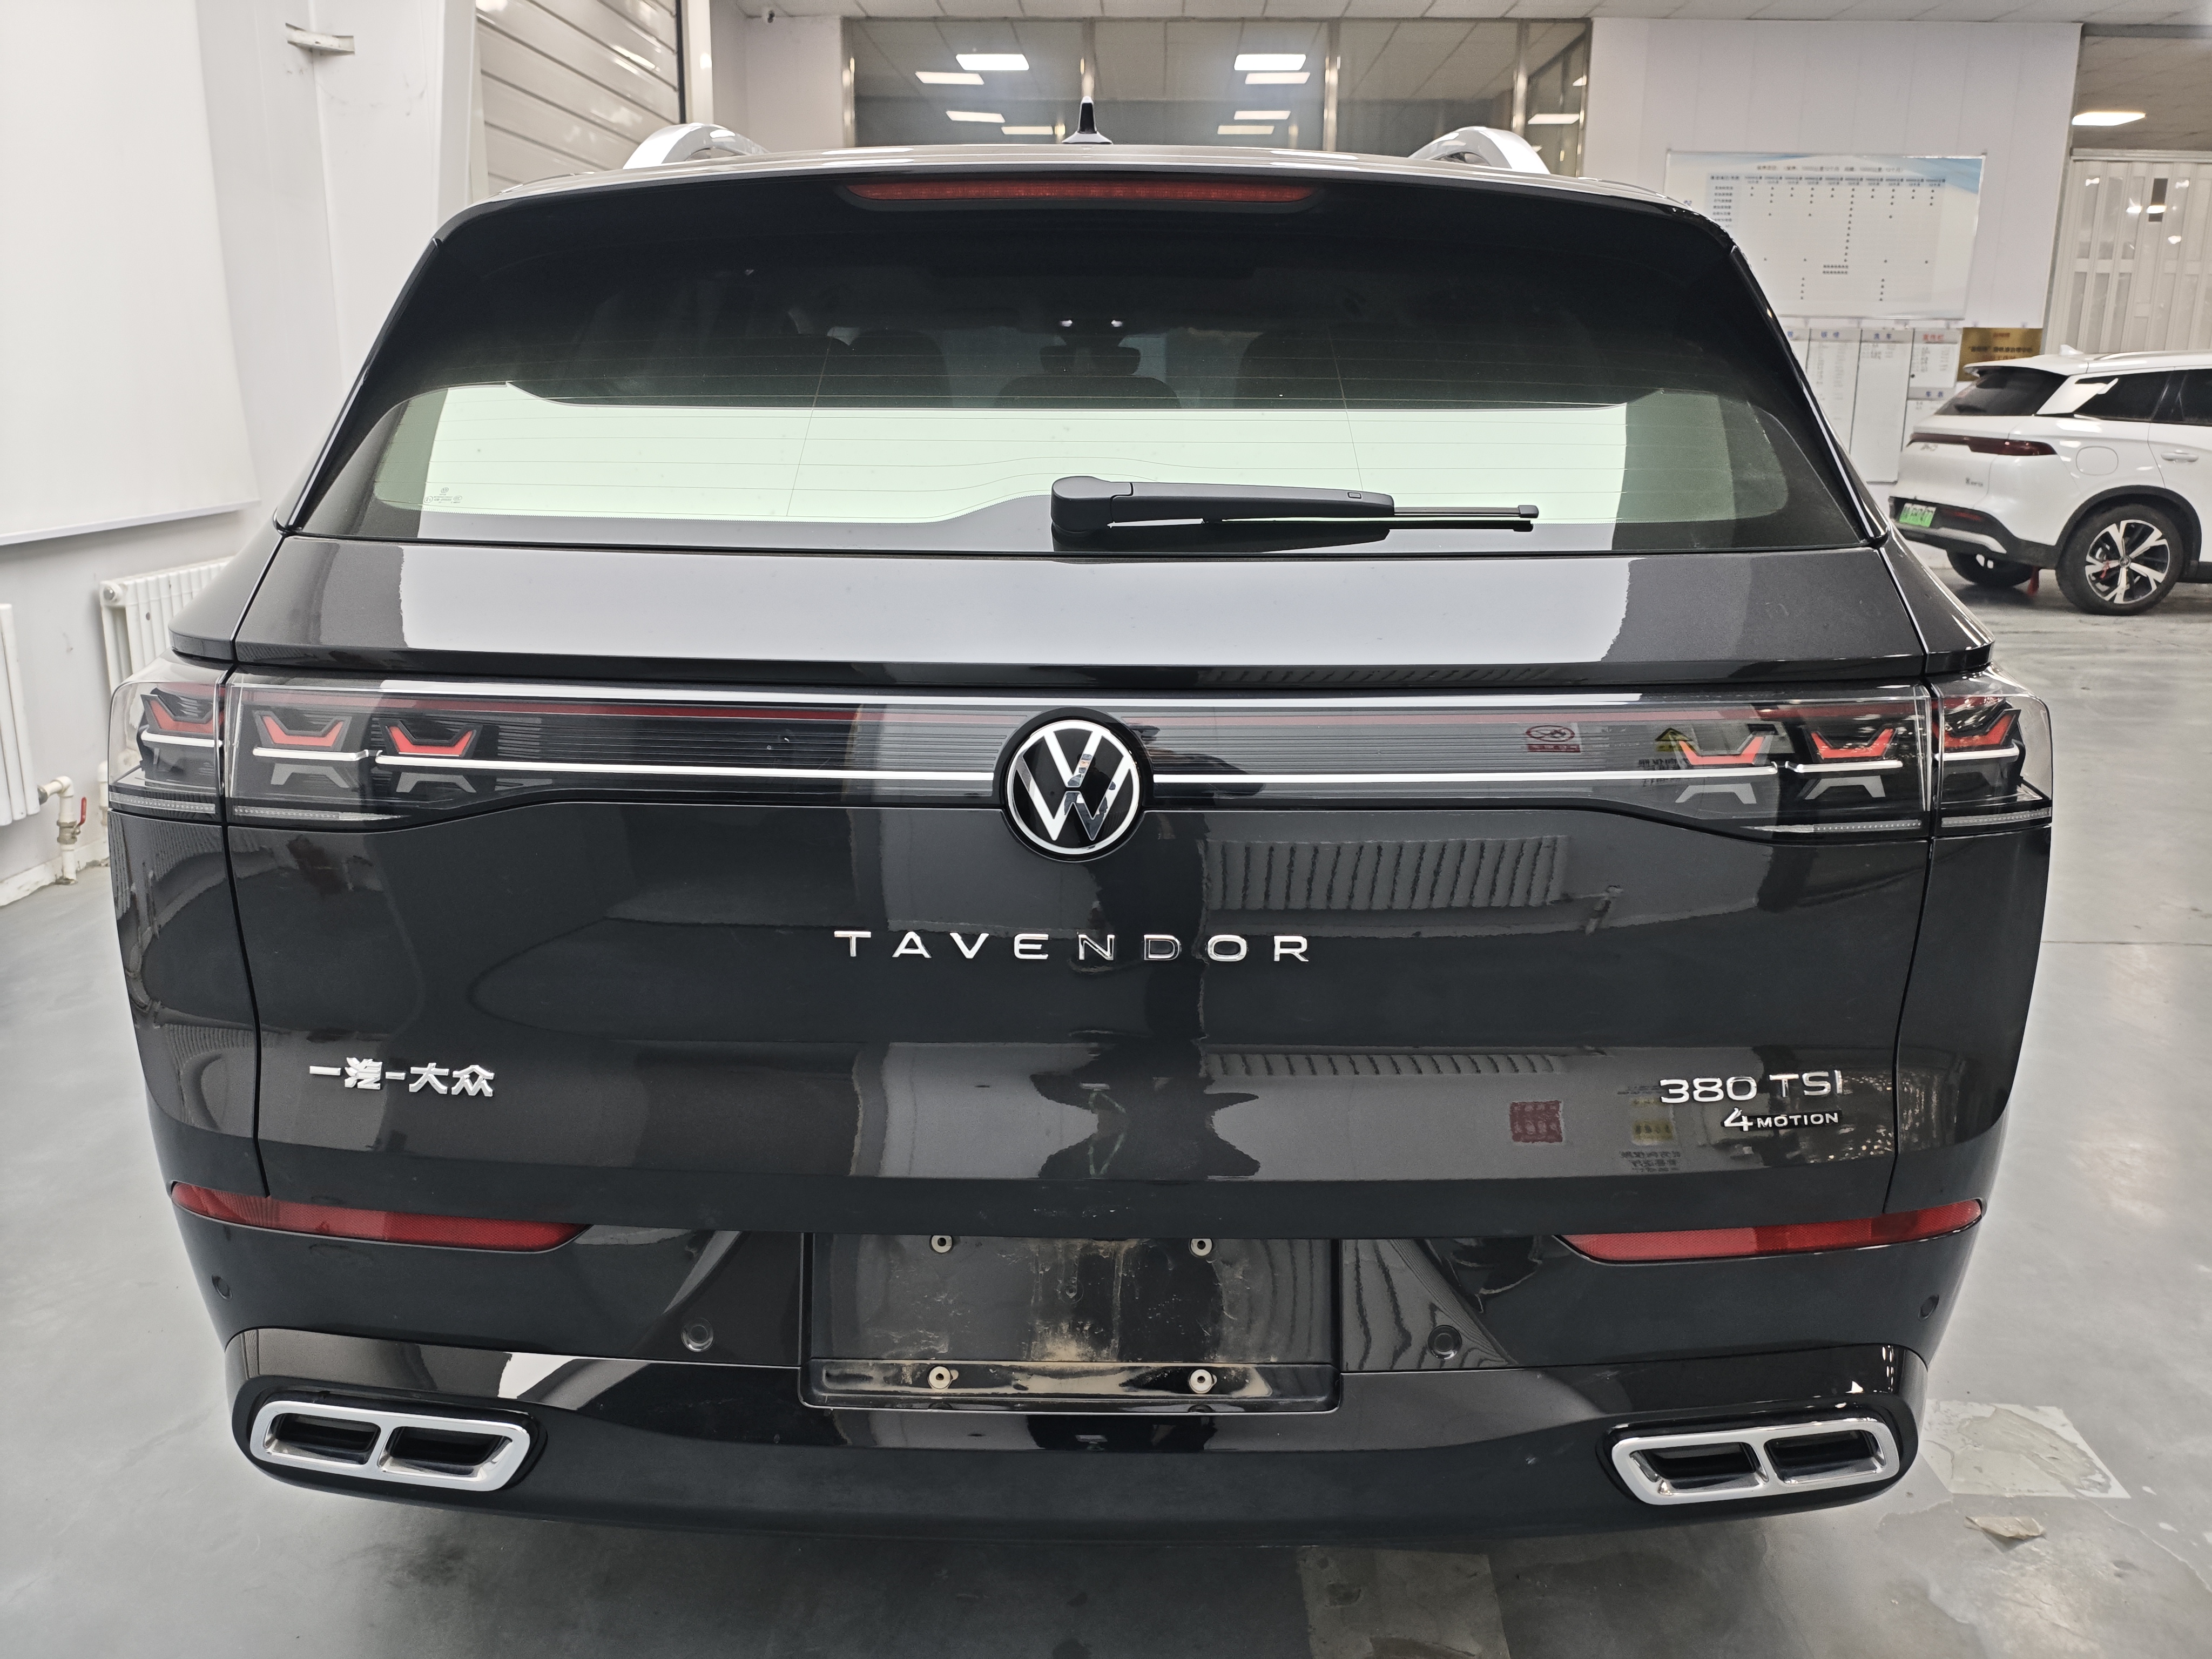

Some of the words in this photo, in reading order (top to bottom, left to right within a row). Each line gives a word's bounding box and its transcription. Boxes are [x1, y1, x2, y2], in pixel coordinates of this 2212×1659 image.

[834, 930, 1310, 962] TAVENDOR
[309, 1057, 495, 1097] 一汽-大众
[1659, 1076, 1758, 1104] 380
[1769, 1070, 1844, 1097] TSI
[1723, 1107, 1839, 1132] 4MOTION
